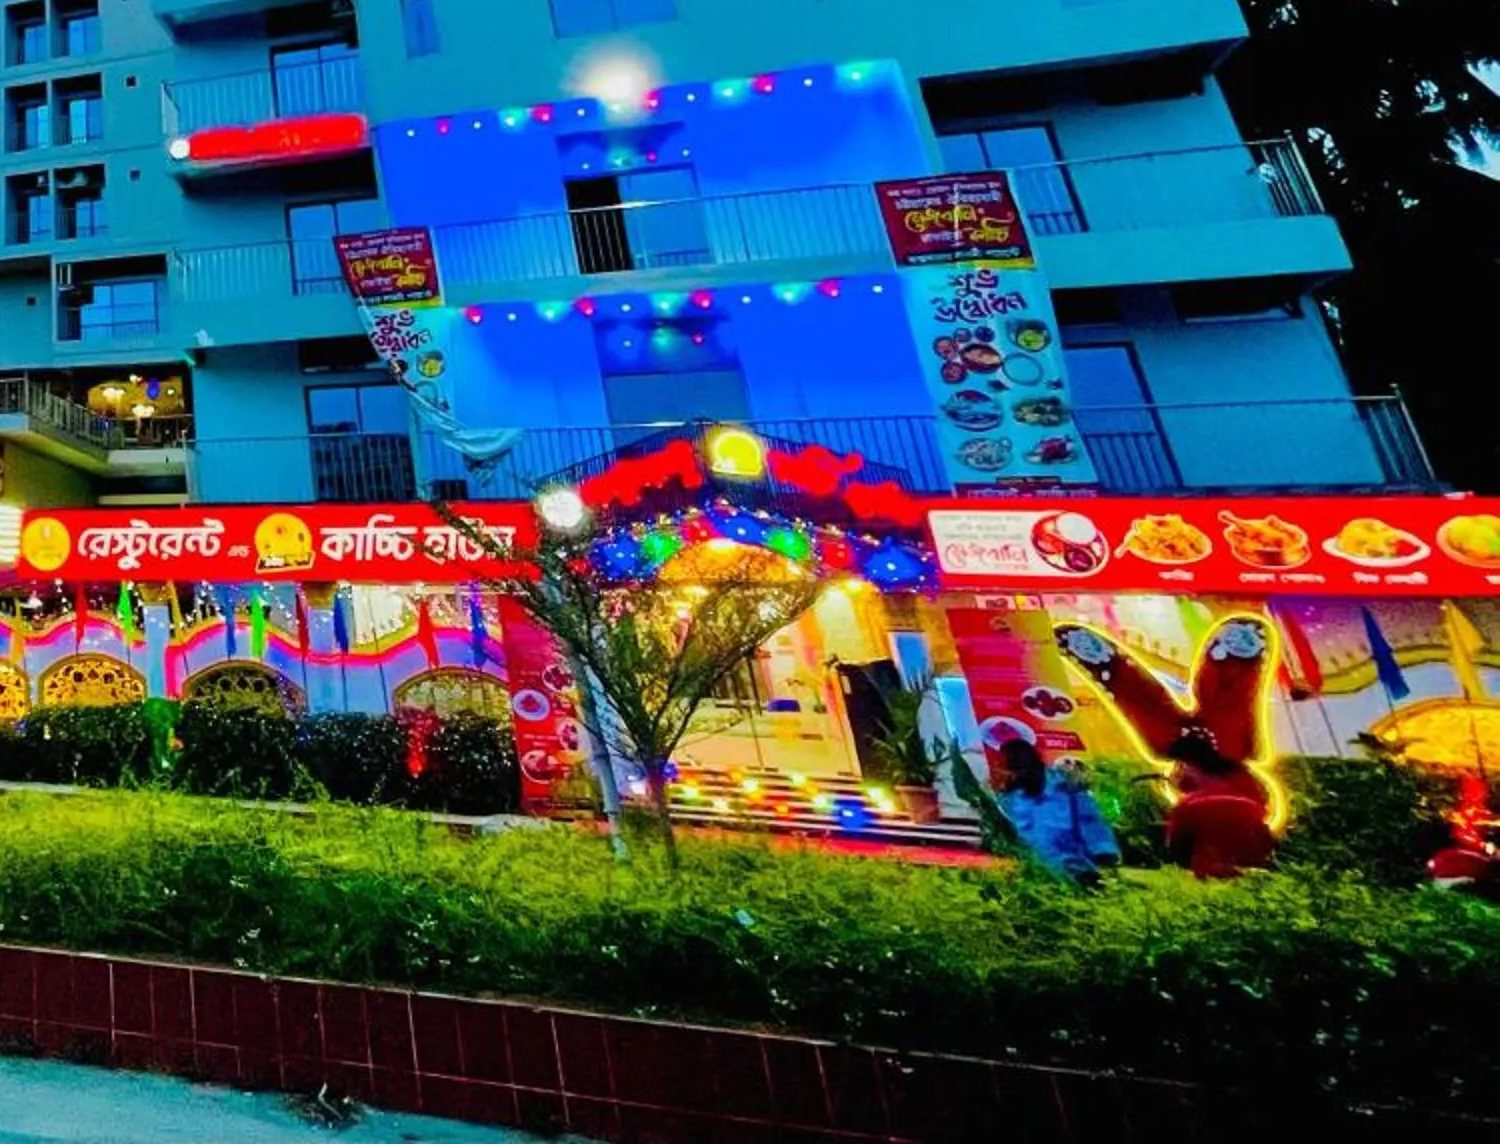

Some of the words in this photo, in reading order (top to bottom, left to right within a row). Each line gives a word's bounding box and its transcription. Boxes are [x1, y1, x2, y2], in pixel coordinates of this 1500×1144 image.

[947, 269, 1000, 298] শুভ
[930, 291, 1028, 324] উদ্বোধন
[77, 518, 225, 570] রেস্টুরেন্ট
[320, 513, 419, 562] কাচ্চি
